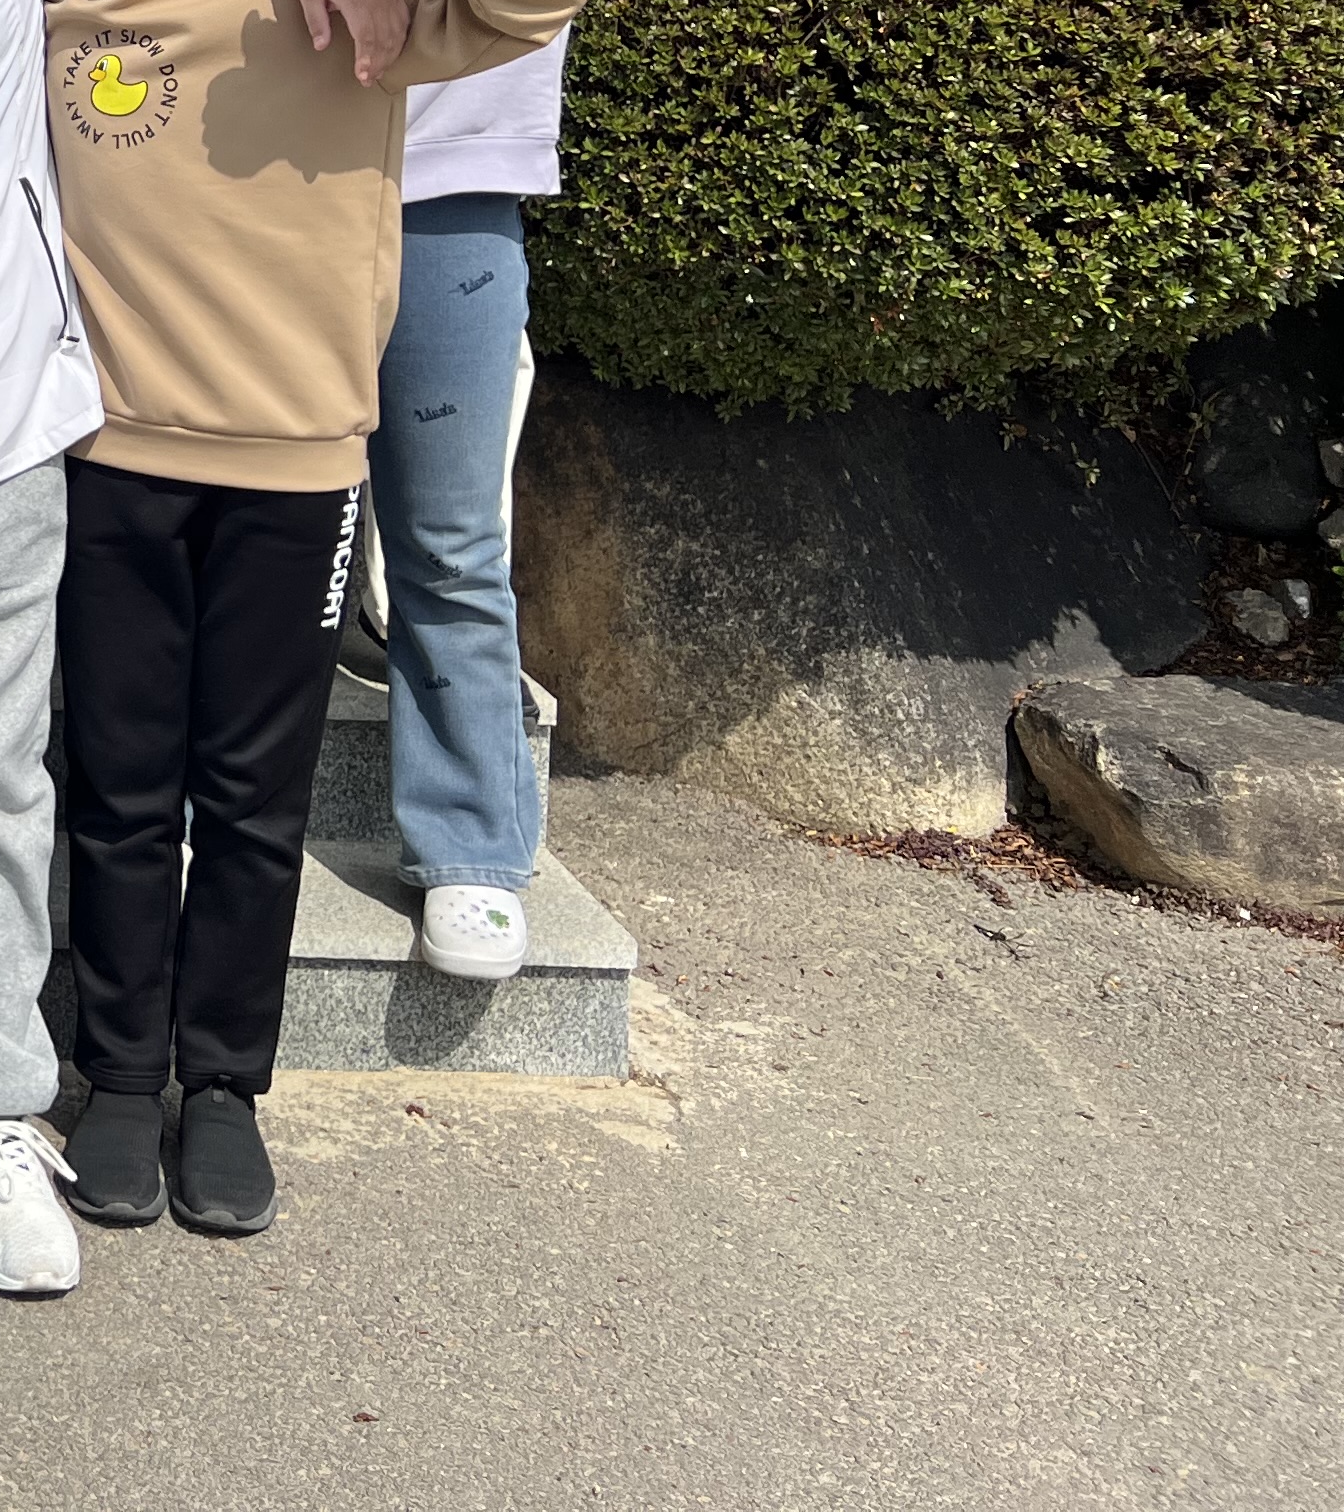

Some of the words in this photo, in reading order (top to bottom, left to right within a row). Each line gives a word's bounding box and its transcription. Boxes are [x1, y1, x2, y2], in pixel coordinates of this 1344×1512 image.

[95, 30, 111, 47] IT
[120, 29, 164, 57] SLOW
[63, 41, 92, 88] TAKE
[65, 101, 104, 144] AWAY
[112, 123, 155, 149] PULL
